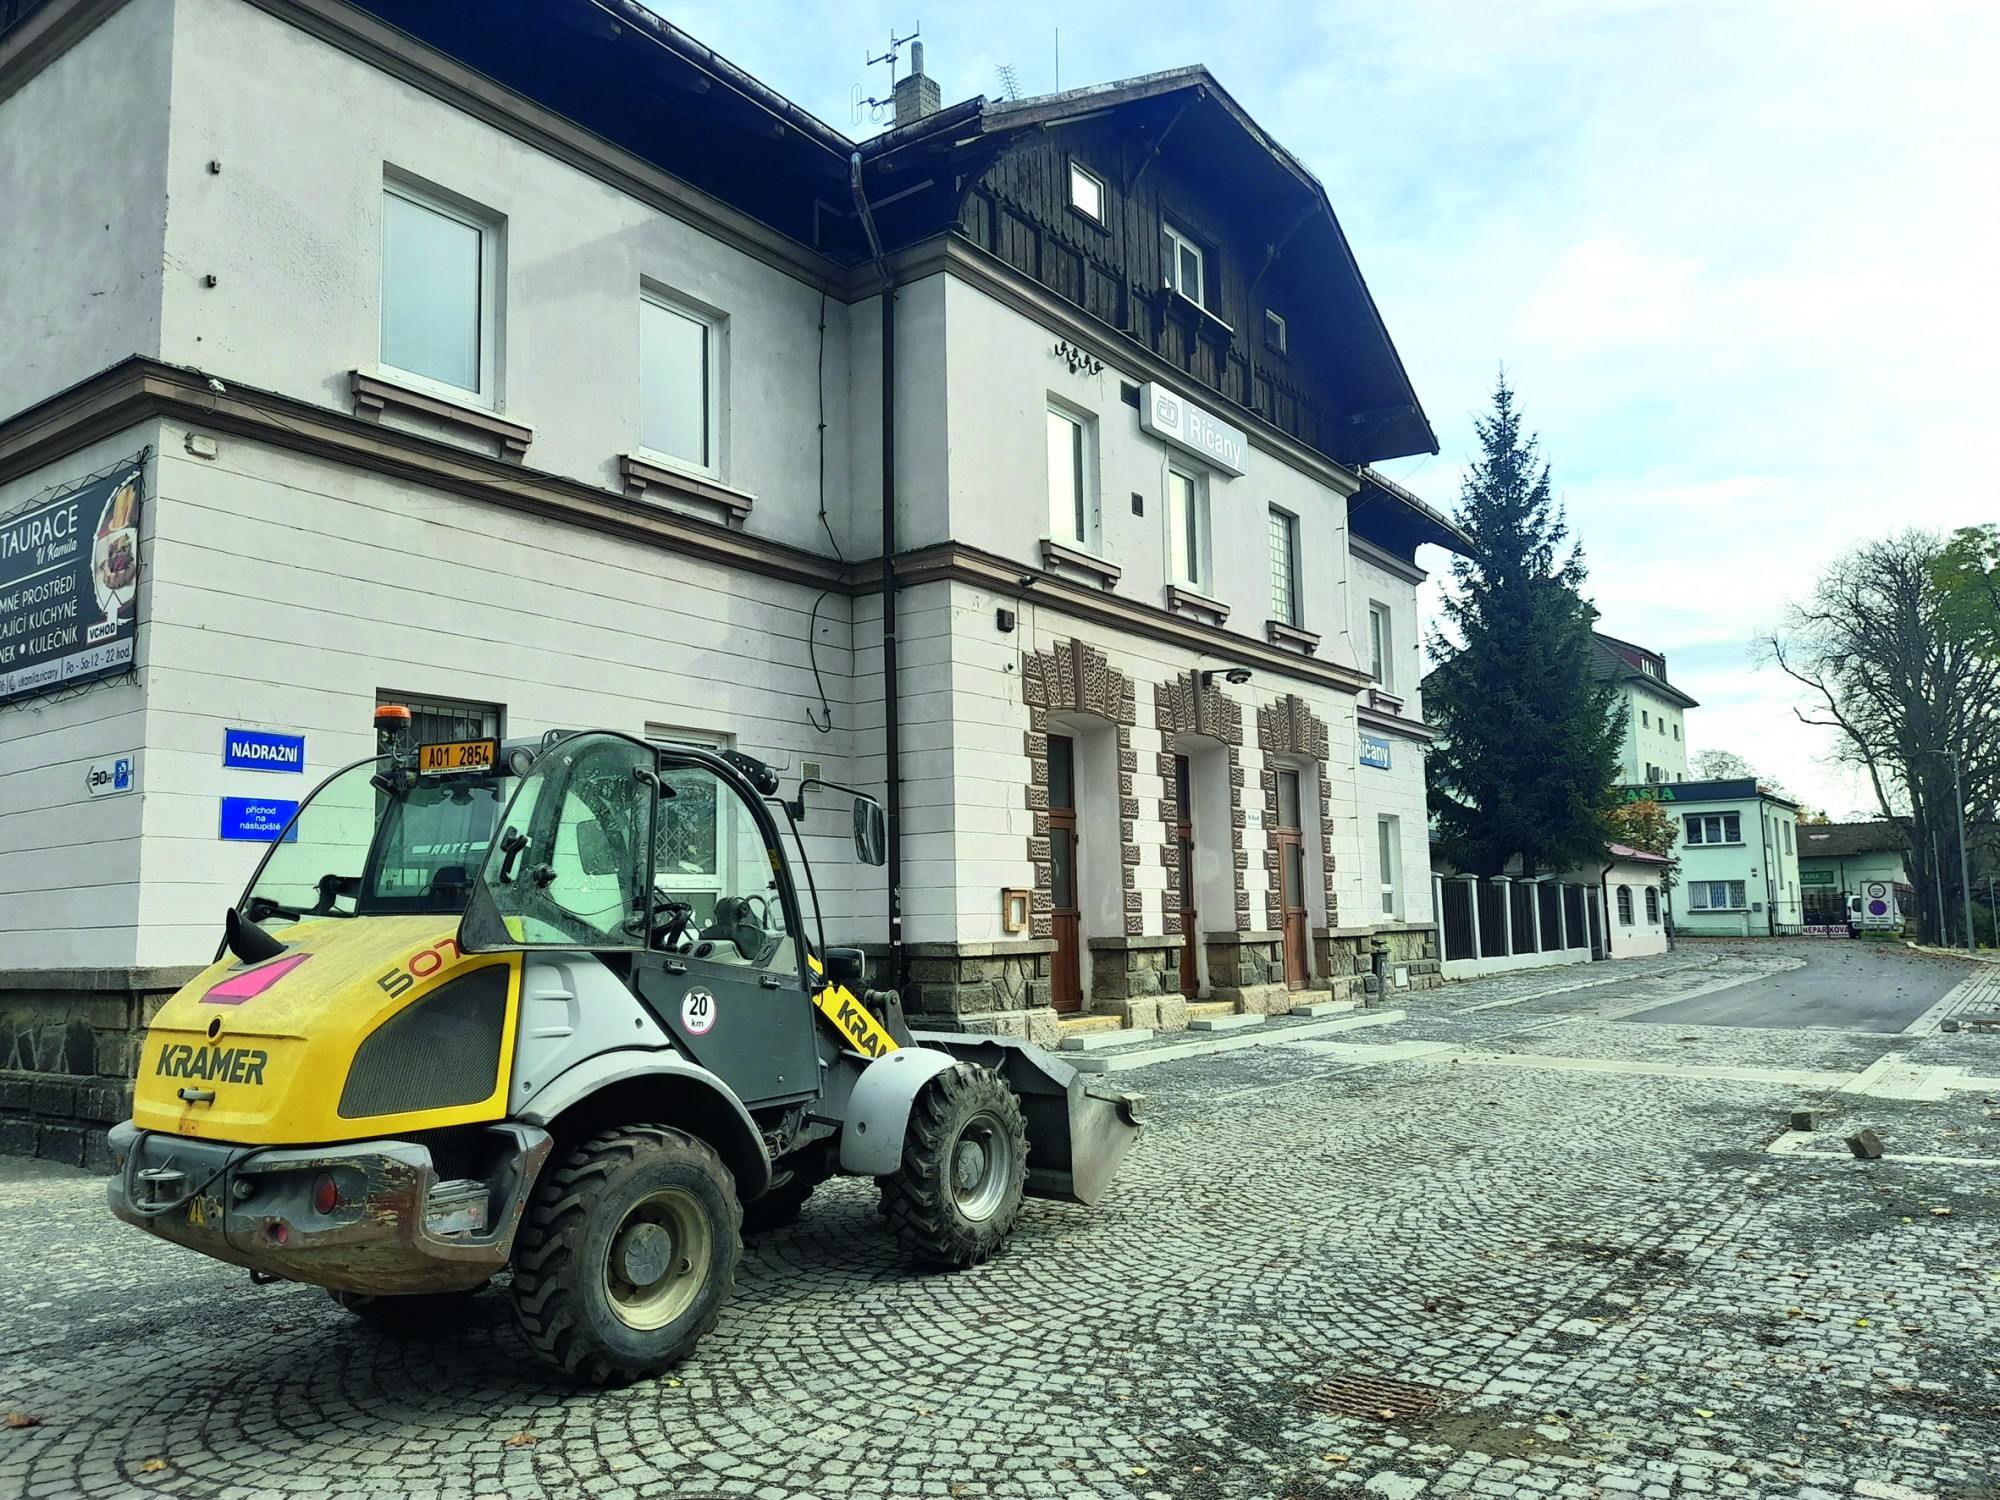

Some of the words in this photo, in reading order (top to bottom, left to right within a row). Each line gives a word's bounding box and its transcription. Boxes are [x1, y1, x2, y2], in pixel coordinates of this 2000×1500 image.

[1190, 406, 1241, 470] Říčany
[0, 504, 79, 559] TAURACE
[22, 570, 77, 608] PROSTŘEDÍ
[29, 596, 78, 630] KUCHYNĚ
[29, 623, 78, 656] KULEČNÍK
[90, 622, 116, 640] VCHOD
[106, 648, 115, 664] 22
[231, 741, 298, 763] NÁDRAŽNÍ
[429, 747, 450, 768] A01
[459, 745, 490, 766] 2854
[245, 806, 277, 815] příchod
[239, 822, 281, 831] nástupiště
[431, 842, 470, 856] ARTE
[689, 995, 708, 1017] 20
[691, 1018, 704, 1028] km
[156, 1043, 268, 1086] KRAMER
